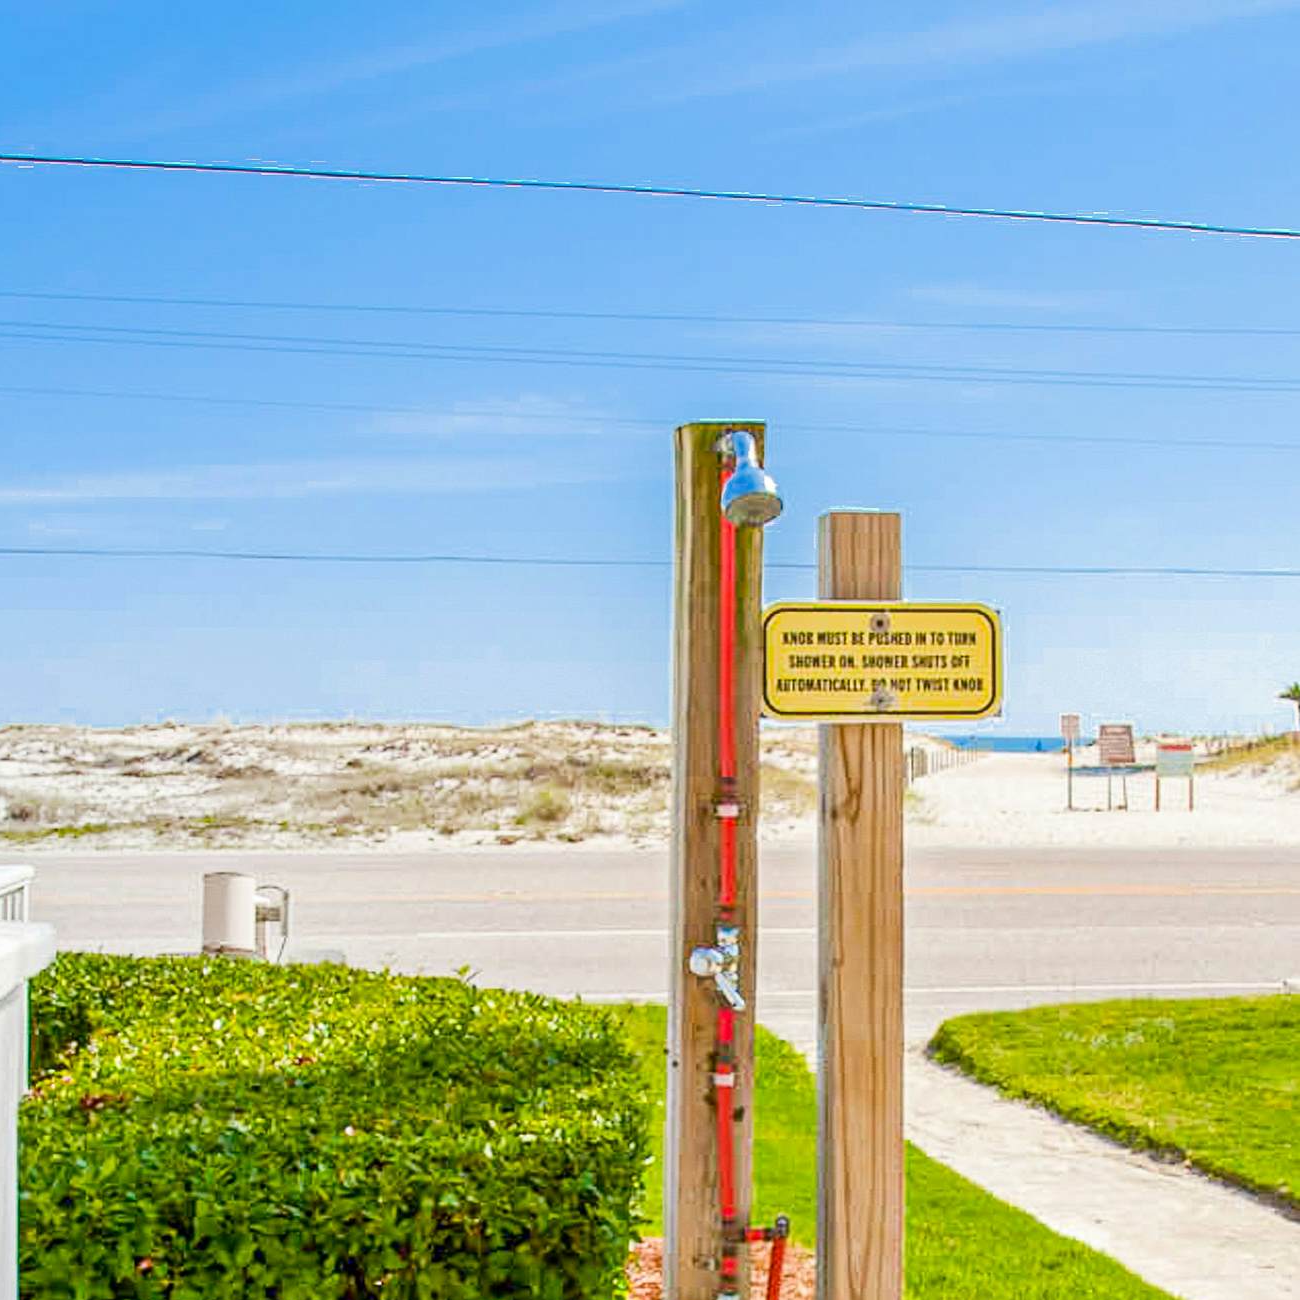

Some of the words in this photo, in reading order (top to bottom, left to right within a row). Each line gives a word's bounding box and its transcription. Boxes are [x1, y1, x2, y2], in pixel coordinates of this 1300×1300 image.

[781, 631, 813, 646] KNOB
[817, 631, 847, 646] MUST
[851, 631, 864, 646] BE
[868, 631, 912, 646] PUSHED
[915, 631, 926, 646] IN
[931, 631, 944, 646] TO
[947, 631, 976, 646] TURN
[789, 654, 835, 669] SHOWER
[862, 654, 908, 669] SHOWER
[912, 654, 947, 669] SHUTS
[951, 654, 970, 669] OFF
[890, 678, 911, 692] NOT
[916, 678, 949, 692] TWIST
[953, 678, 983, 692] KNOB
